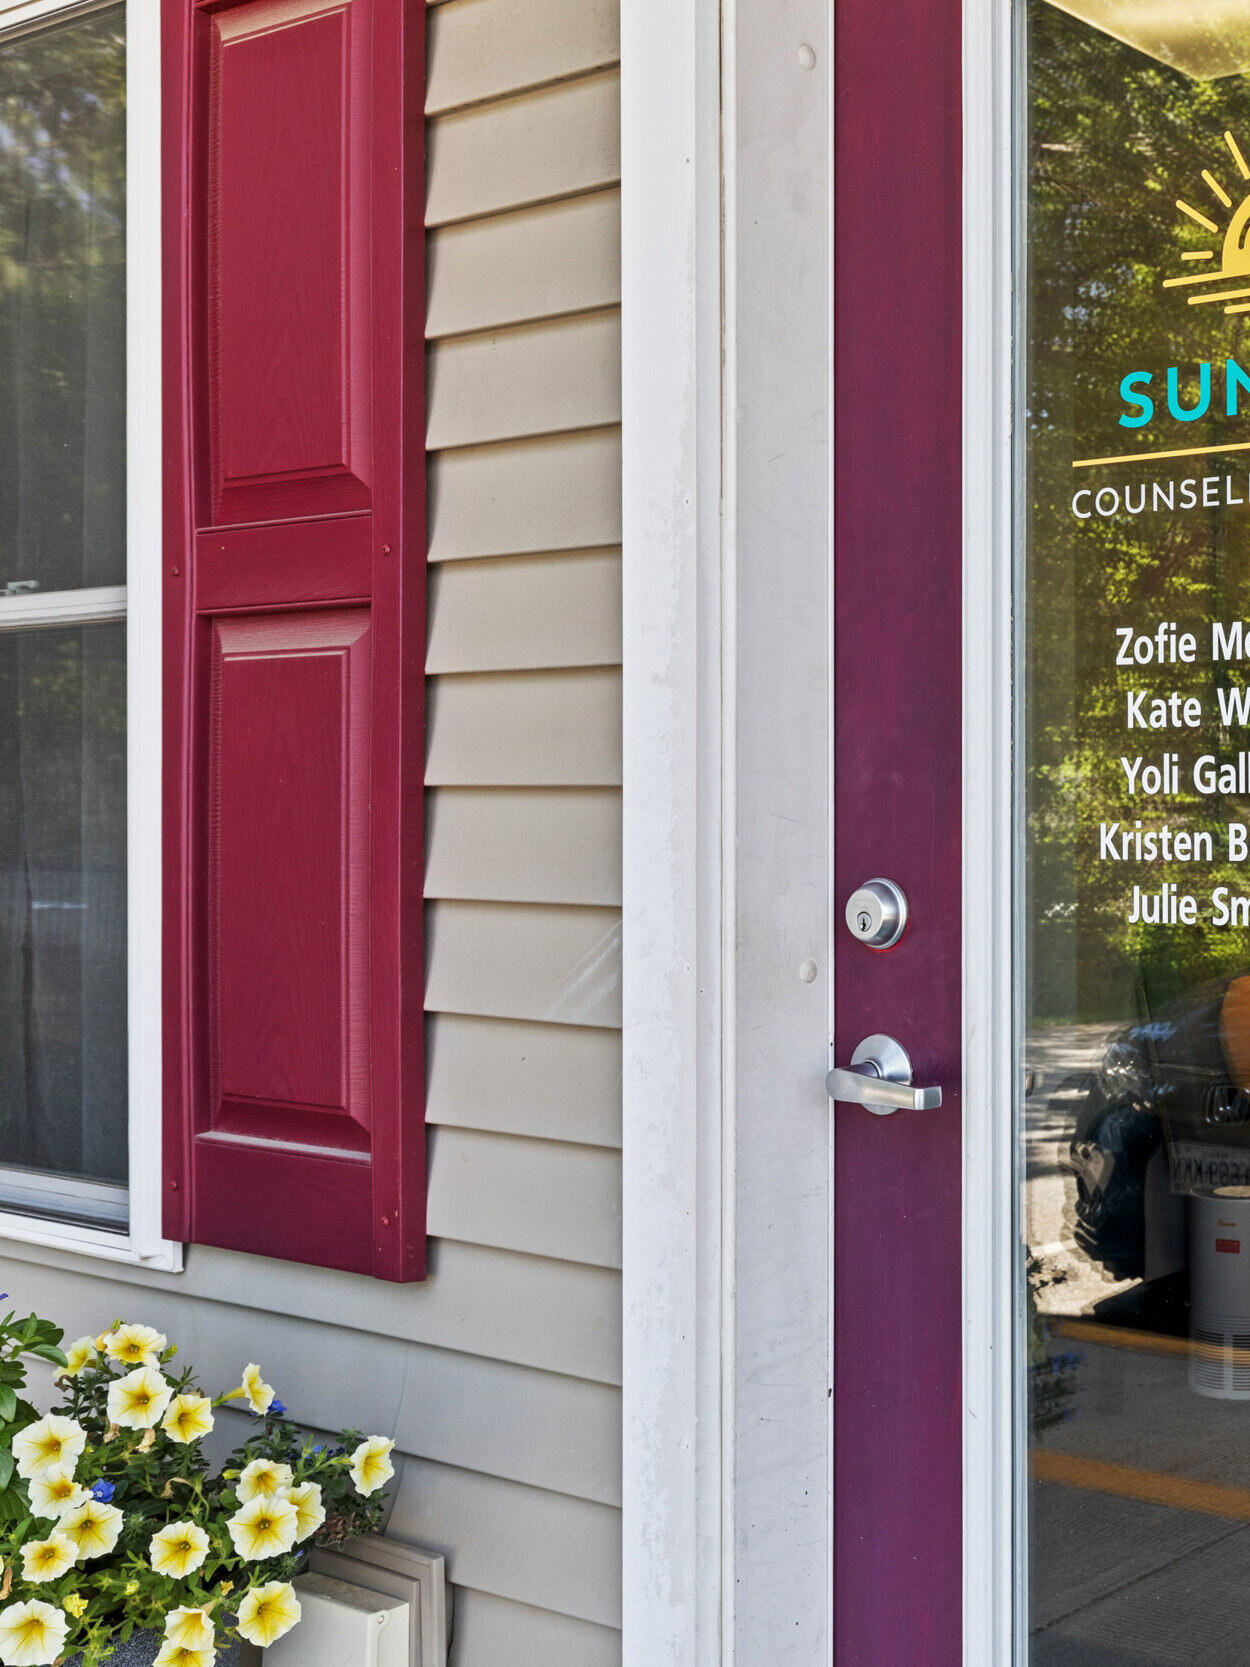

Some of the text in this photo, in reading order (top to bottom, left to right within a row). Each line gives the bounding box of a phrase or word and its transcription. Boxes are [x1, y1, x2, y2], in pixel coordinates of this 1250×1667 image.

[1115, 621, 1197, 666] Zofie
[1127, 690, 1202, 729] Kate
[1120, 753, 1179, 795] Yoli
[1100, 820, 1213, 862] Kristen
[1128, 882, 1198, 925] Julie
